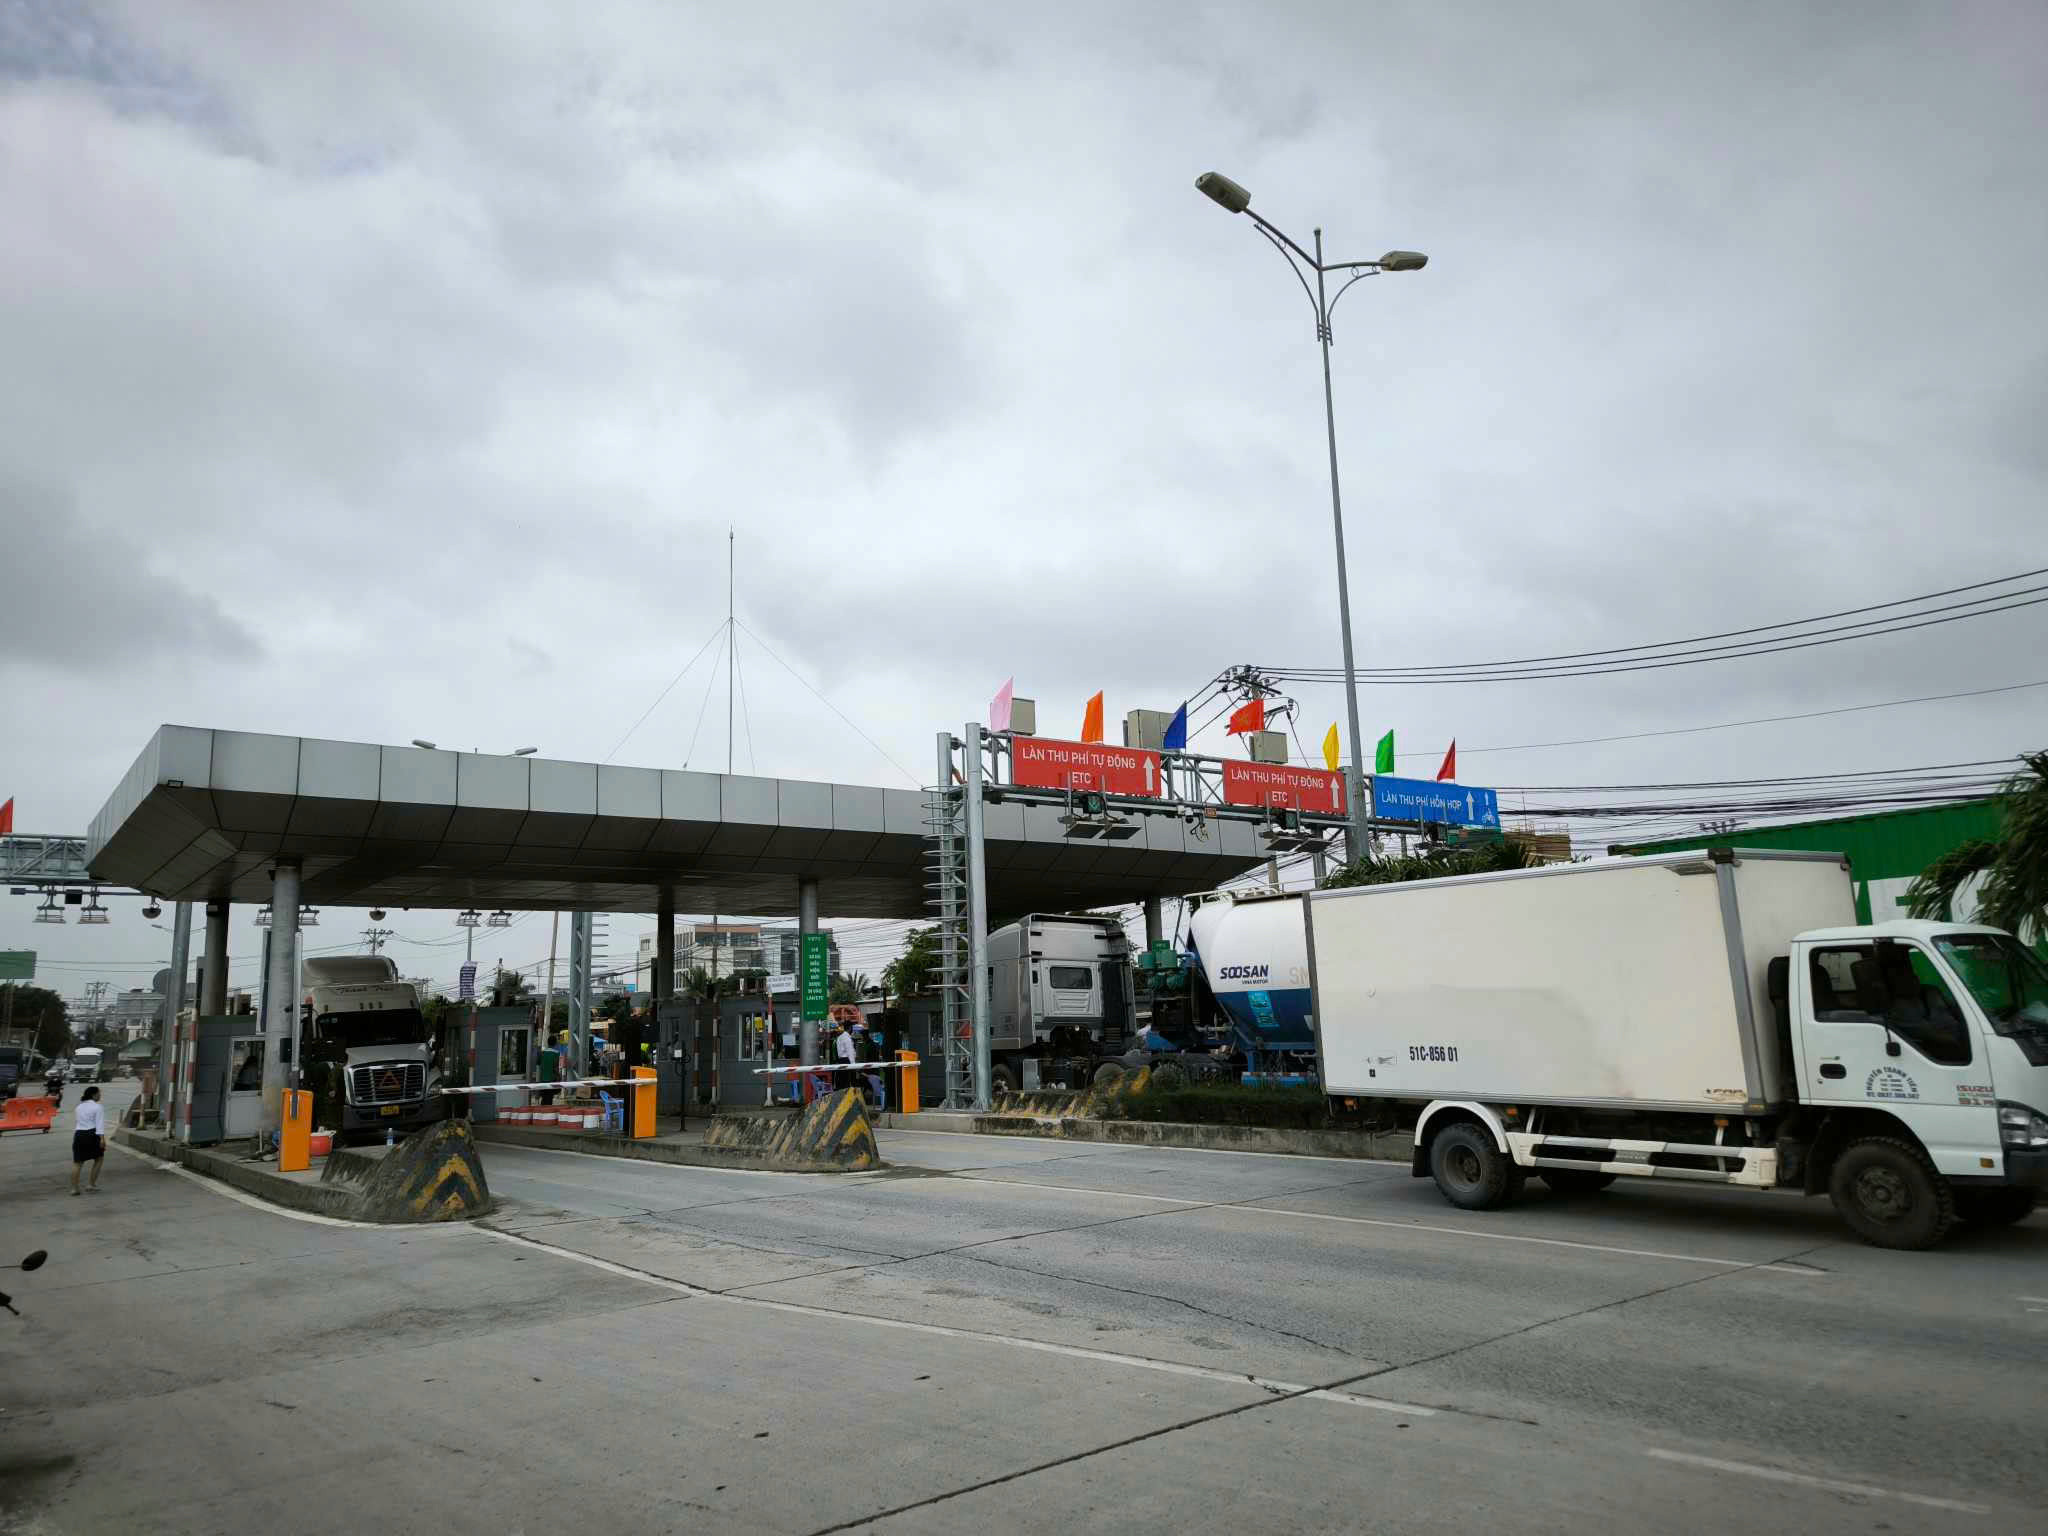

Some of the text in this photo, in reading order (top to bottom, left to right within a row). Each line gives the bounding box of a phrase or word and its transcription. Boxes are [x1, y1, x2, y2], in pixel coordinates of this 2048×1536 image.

[1022, 745, 1136, 770] LÀN THU PHÍ TỰ ĐỘNG
[1072, 771, 1092, 784] ETC
[1231, 767, 1325, 790] LÀN THU PHÍ TỰ ĐỘNG
[1272, 791, 1288, 802] ETC
[1381, 790, 1398, 804] LÀN
[1399, 794, 1414, 805] THU
[1415, 795, 1429, 807] PHÍ
[1220, 965, 1269, 979] SOOSAN
[1956, 1085, 1993, 1093] ISUZU
